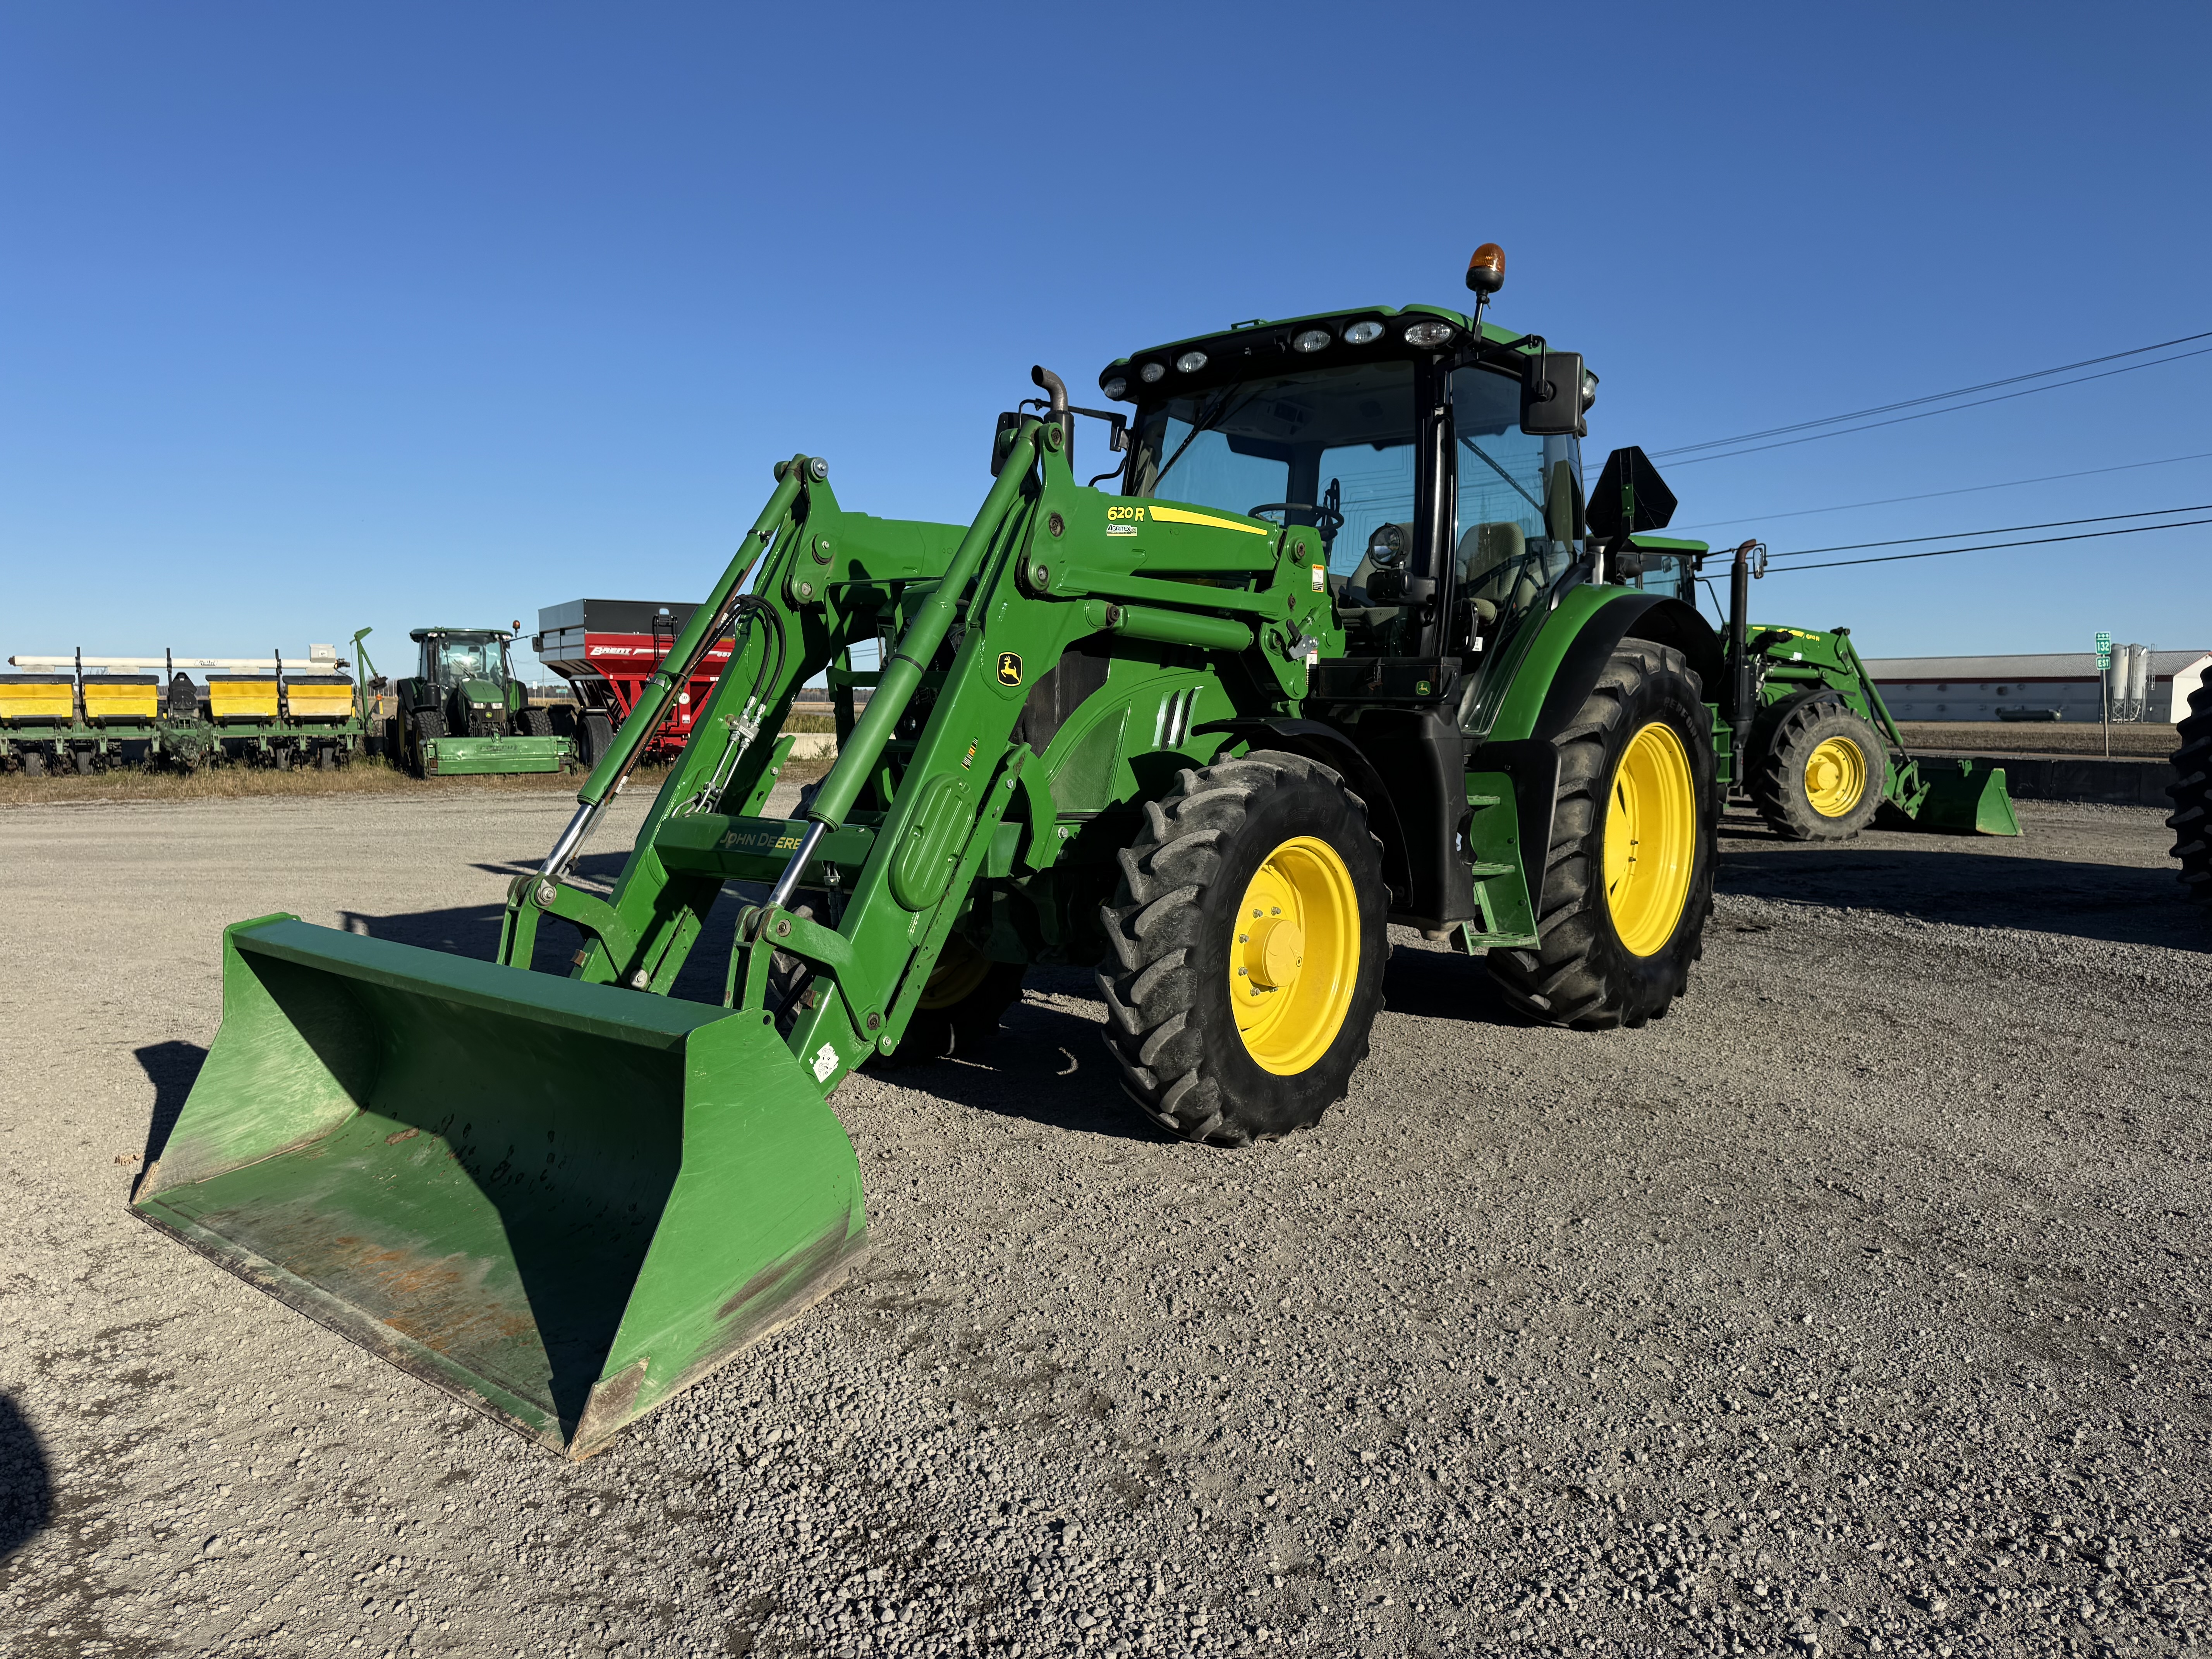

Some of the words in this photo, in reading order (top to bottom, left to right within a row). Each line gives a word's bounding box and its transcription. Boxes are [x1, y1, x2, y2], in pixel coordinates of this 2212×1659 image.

[2097, 641, 2109, 651] 132
[720, 830, 756, 845] JOHN
[756, 833, 803, 850] DEERE
